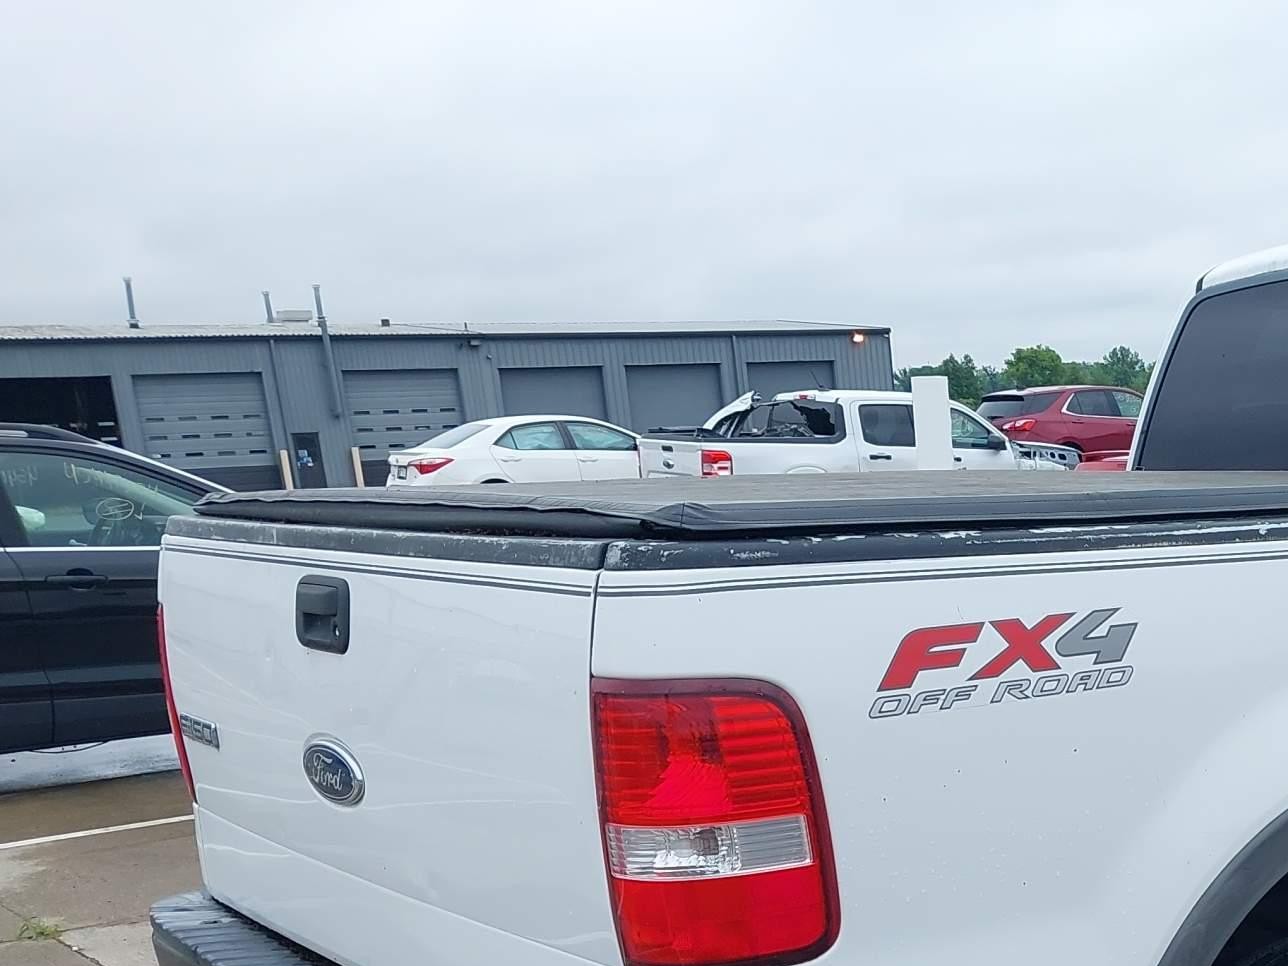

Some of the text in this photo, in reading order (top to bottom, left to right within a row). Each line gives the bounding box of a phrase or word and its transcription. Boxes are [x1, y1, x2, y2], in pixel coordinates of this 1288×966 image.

[877, 607, 1139, 692] FX4
[869, 665, 1134, 719] OFF ROAD
[310, 752, 344, 792] Ford
